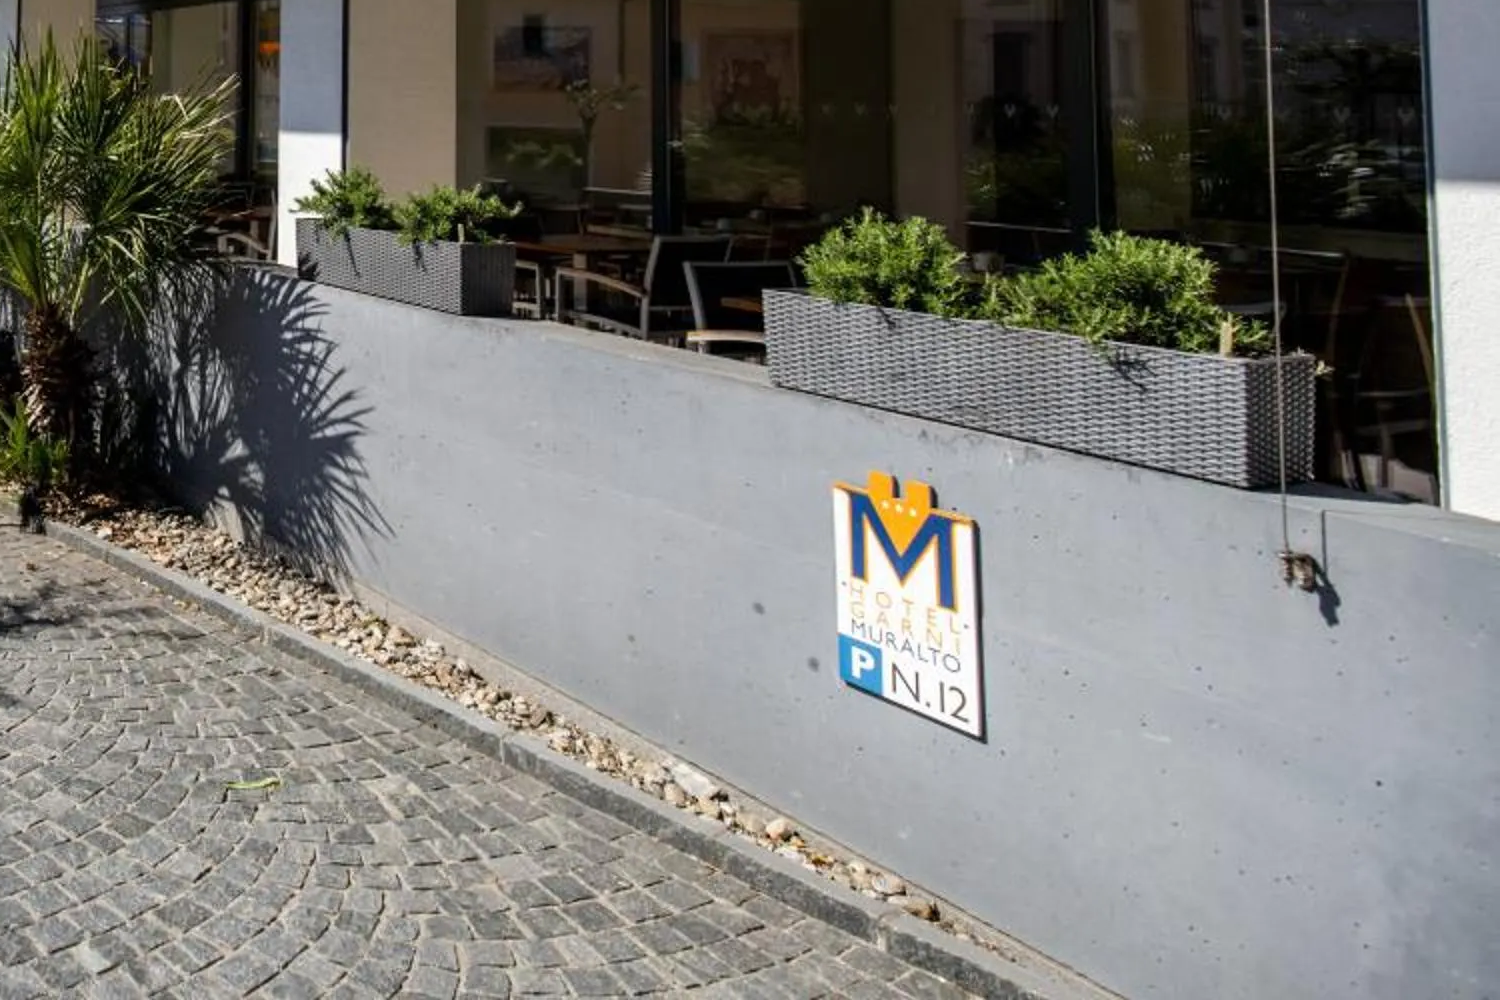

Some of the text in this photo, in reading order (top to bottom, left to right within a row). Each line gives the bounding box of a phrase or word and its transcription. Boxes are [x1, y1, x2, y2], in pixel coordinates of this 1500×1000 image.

[850, 493, 957, 612] M
[851, 582, 961, 635] HOTEL
[851, 601, 960, 656] GARNI
[851, 618, 961, 673] MURALTO
[851, 645, 970, 724] P N.12
